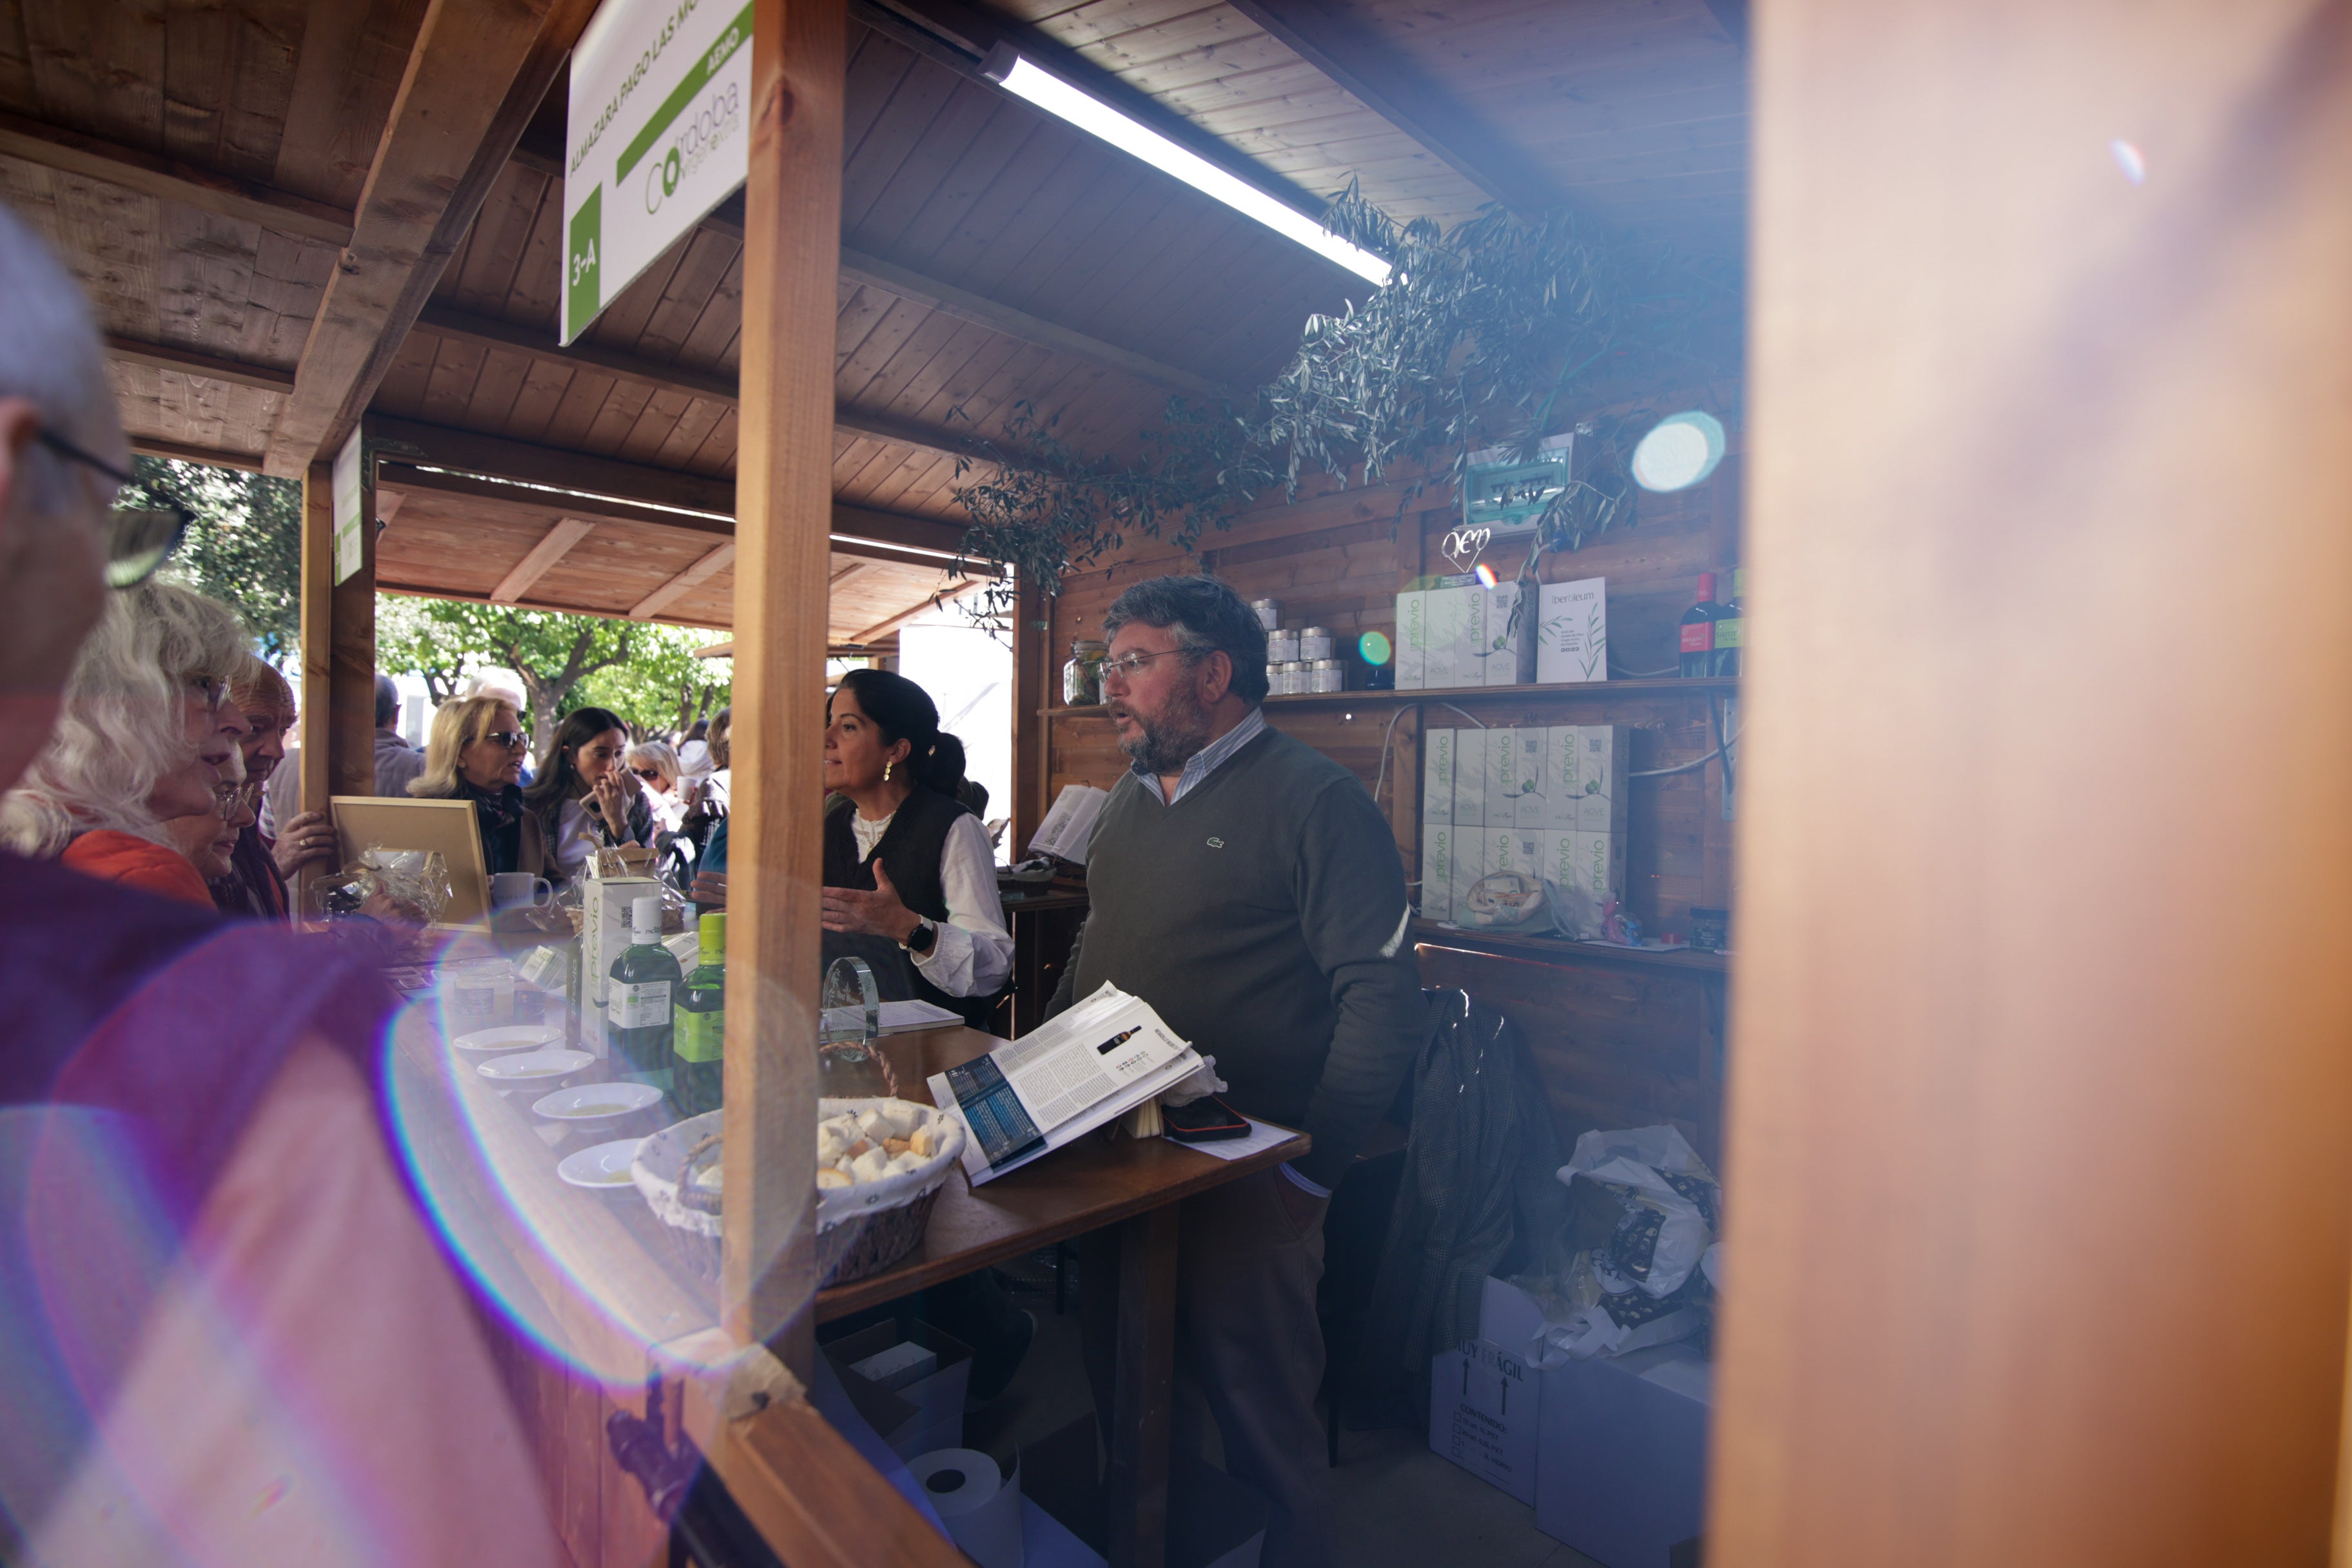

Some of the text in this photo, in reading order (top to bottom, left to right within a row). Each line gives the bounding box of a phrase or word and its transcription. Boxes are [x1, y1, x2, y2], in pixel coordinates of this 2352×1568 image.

[570, 95, 619, 178] ALMAZARA
[620, 50, 651, 107] PAGO
[652, 15, 675, 63] LAS
[572, 237, 596, 286] 3-A
[1429, 666, 1449, 674] AOVE
[1491, 663, 1511, 671] AOVE
[1460, 1403, 1507, 1434] CONTENIDO:
